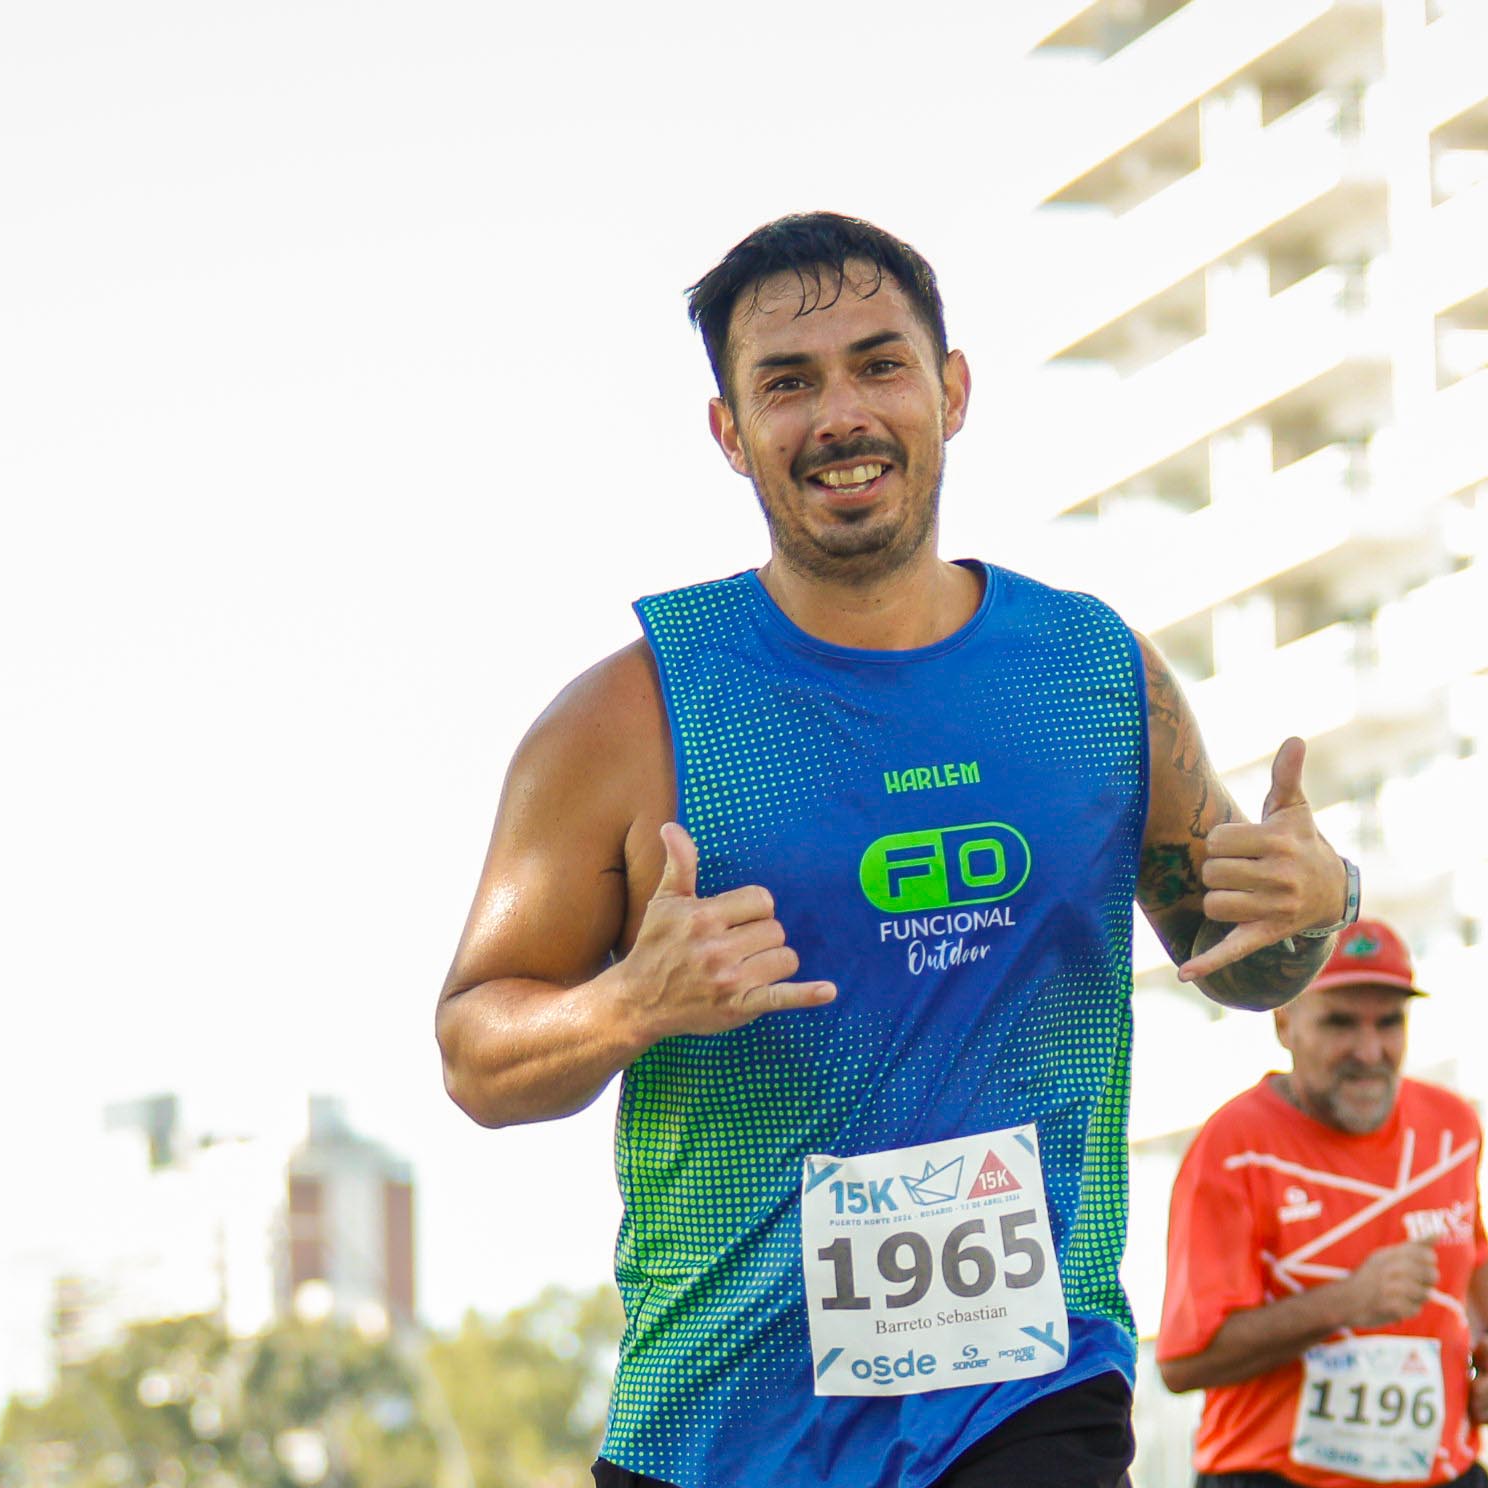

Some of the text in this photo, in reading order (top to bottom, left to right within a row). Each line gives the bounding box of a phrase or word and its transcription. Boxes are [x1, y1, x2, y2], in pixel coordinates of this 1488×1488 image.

[883, 761, 981, 794] HARLEM
[880, 906, 1016, 942] FUNCIONAL
[908, 938, 991, 976] Outdoor
[829, 1177, 899, 1215] 15K
[978, 1169, 1009, 1192] 15K
[818, 1208, 1046, 1311] 1965
[875, 1305, 1008, 1335] Barreto Sebastian
[851, 1349, 937, 1382] osde
[1308, 1379, 1437, 1430] 1196
